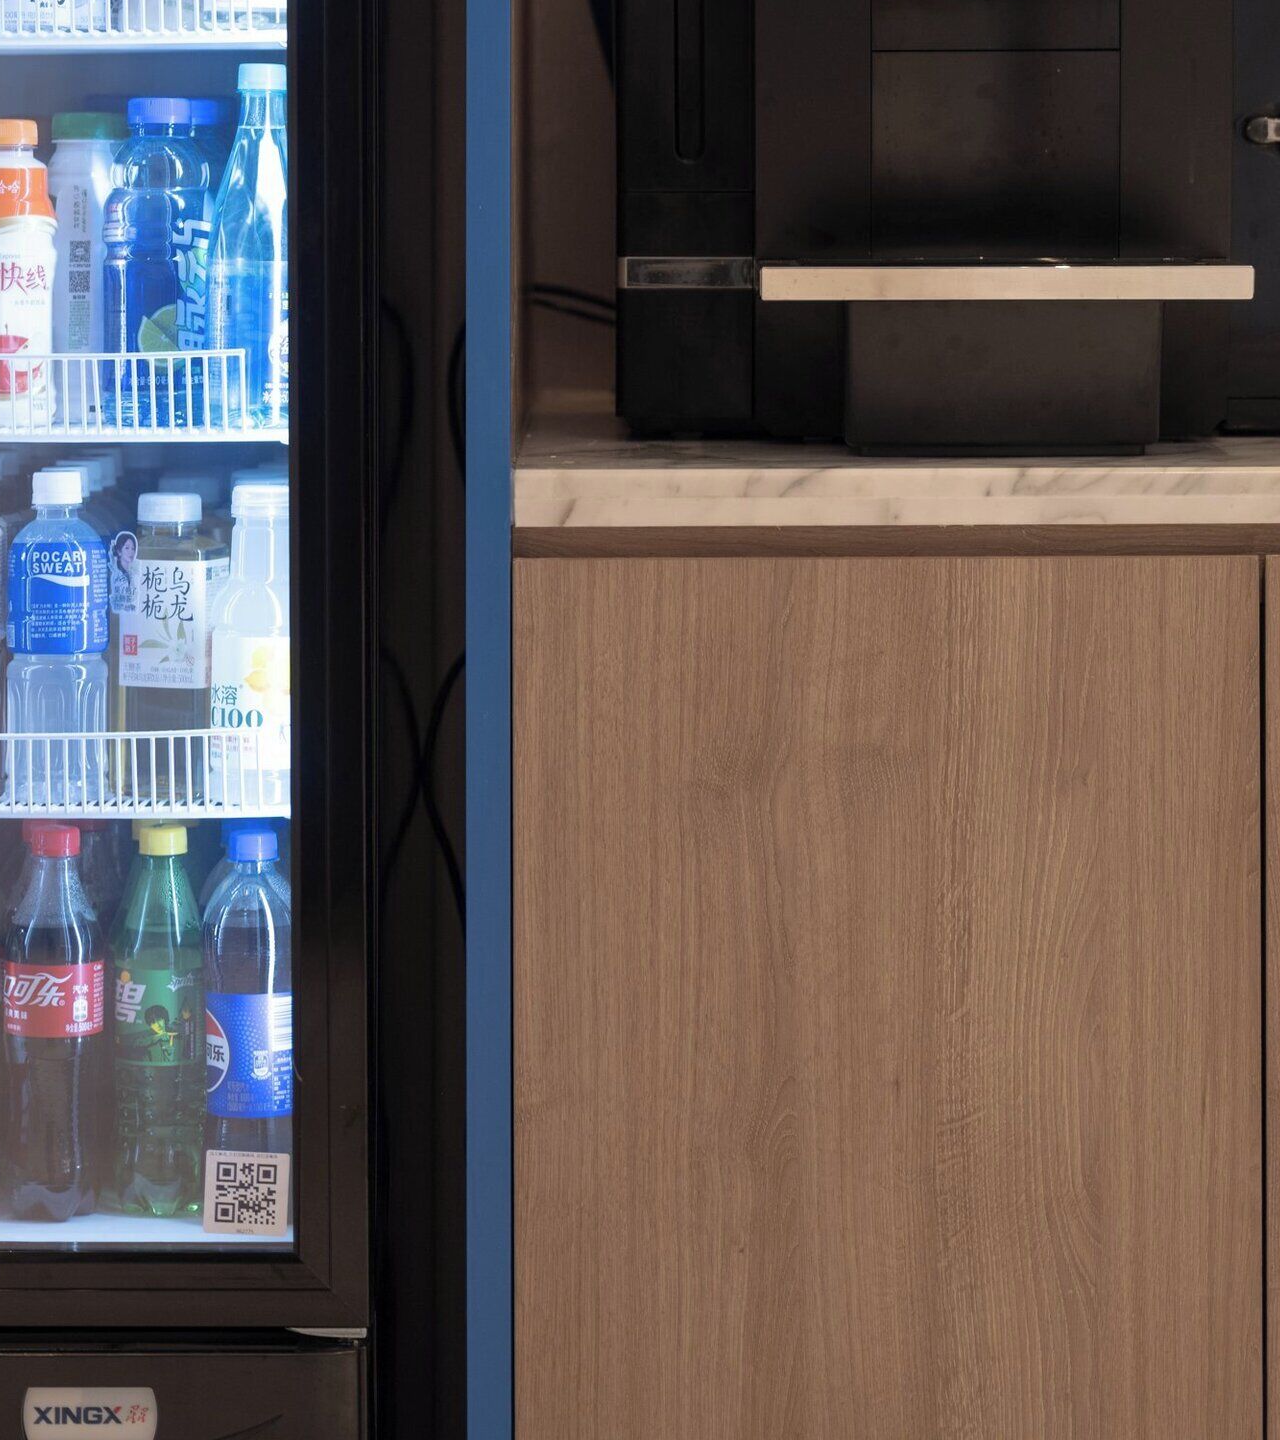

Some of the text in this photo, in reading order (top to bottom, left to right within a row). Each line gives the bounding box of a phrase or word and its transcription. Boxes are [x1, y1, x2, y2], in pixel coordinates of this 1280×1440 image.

[32, 551, 86, 562] POCARI
[32, 562, 83, 573] SWEAT
[212, 683, 238, 705] 水溶
[212, 706, 264, 728] C100
[33, 1406, 122, 1424] XINGX
